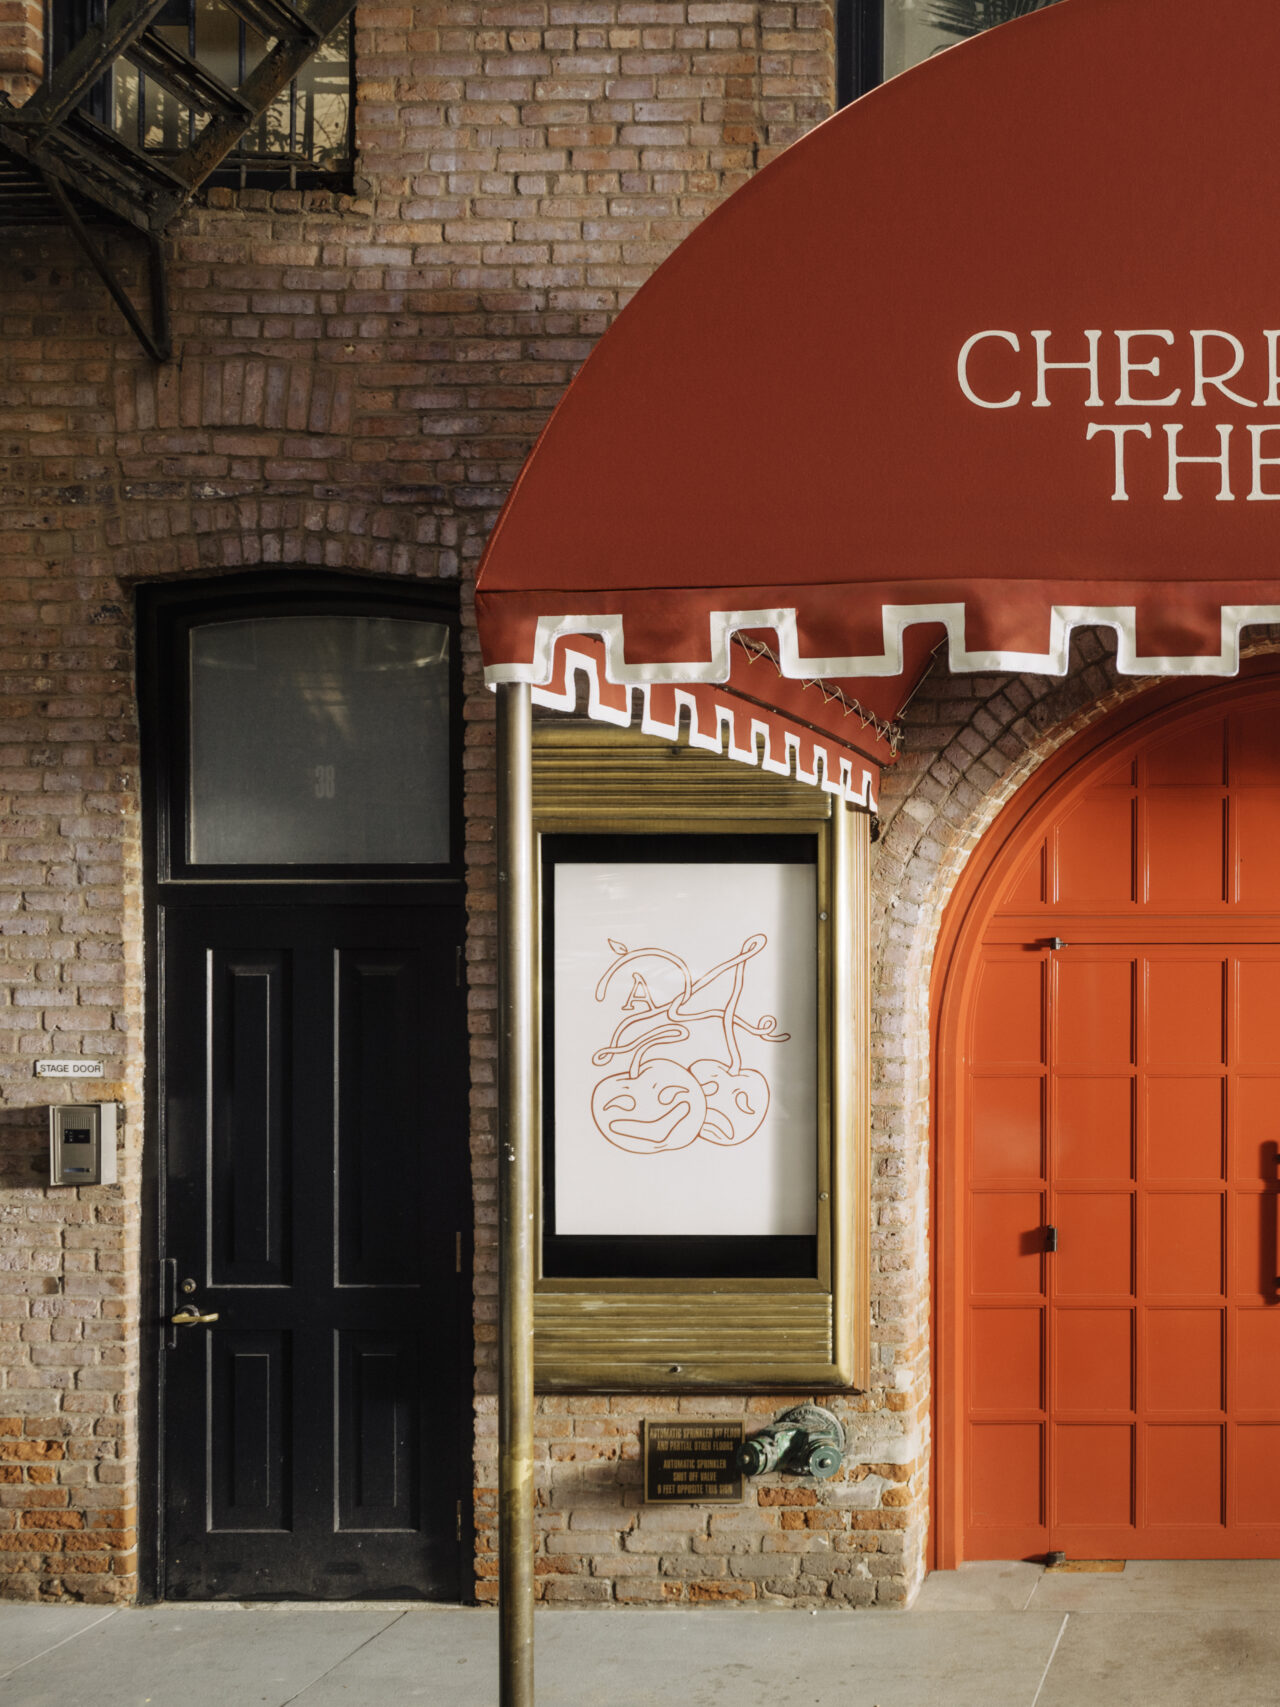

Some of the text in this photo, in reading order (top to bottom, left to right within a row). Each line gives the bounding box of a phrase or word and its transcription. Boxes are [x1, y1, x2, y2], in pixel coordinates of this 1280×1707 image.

[314, 764, 336, 798] 38
[40, 1064, 101, 1073] STAGE DOOR
[649, 1428, 682, 1439] AUTOMATIC
[683, 1428, 713, 1439] SPRINKLER
[657, 1441, 669, 1451] AND
[663, 1459, 727, 1469] AUTOMATIC SPRINKLER
[700, 1472, 716, 1482] VALVE
[663, 1484, 676, 1495] FEET
